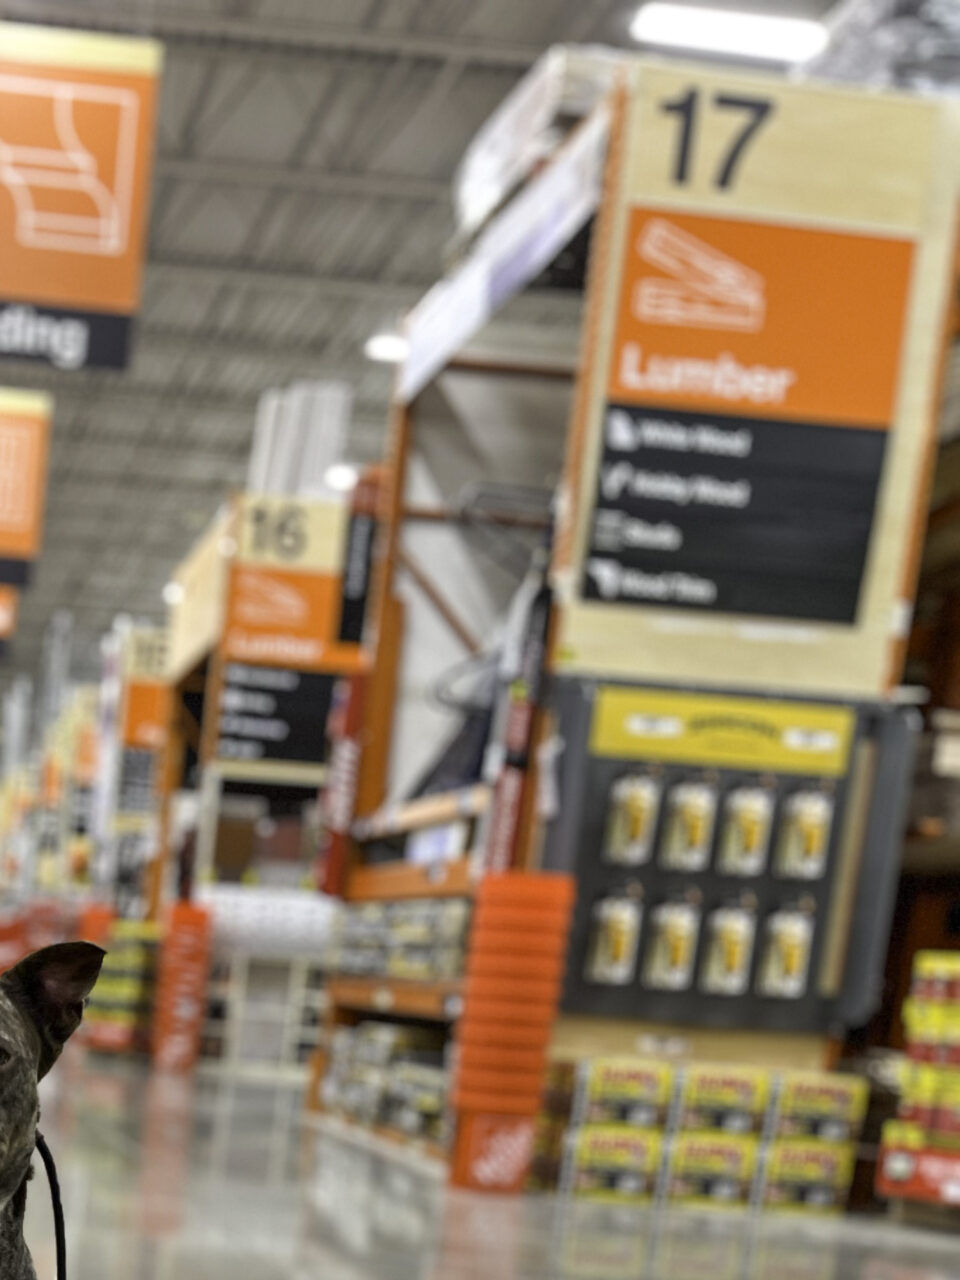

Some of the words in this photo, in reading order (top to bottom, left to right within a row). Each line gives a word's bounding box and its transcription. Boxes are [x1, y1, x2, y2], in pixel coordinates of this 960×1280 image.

[657, 85, 778, 191] 17
[619, 344, 795, 404] Lumber
[250, 505, 308, 560] 16
